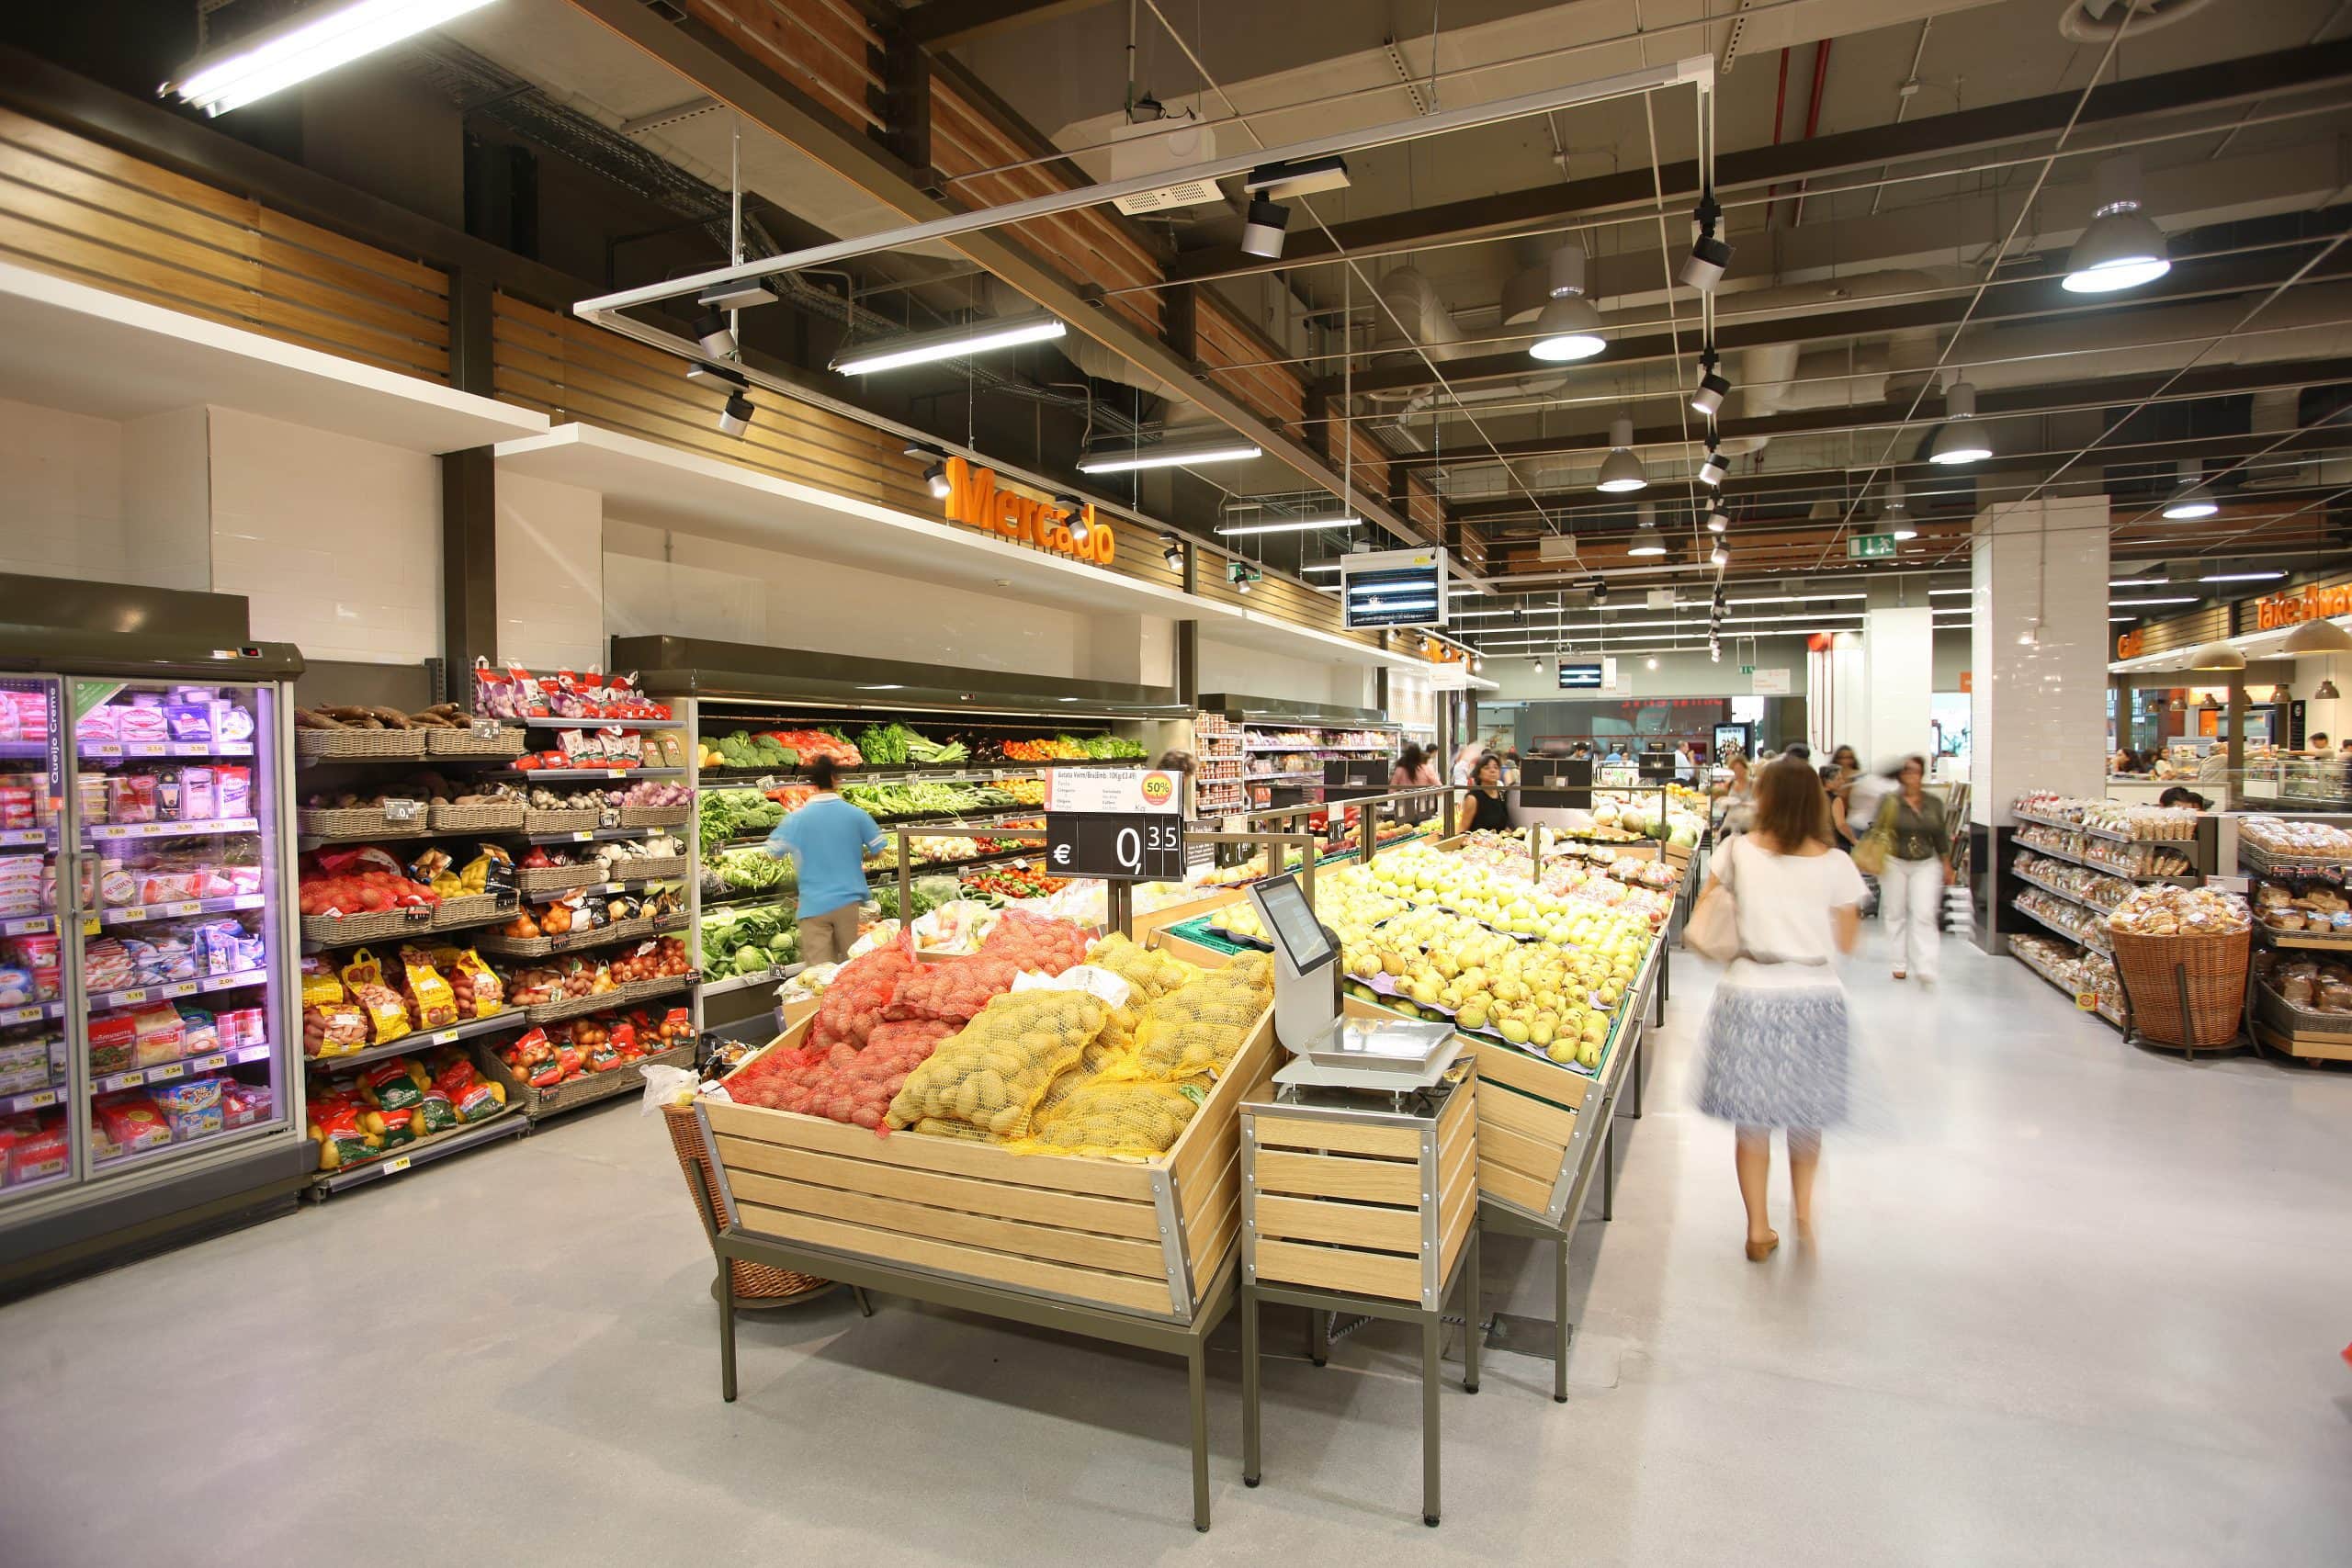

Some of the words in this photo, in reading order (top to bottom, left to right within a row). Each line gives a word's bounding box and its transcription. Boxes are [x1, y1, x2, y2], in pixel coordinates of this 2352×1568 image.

[945, 456, 1114, 564] Mercado
[2255, 592, 2301, 629] Take
[1147, 782, 1170, 793] 50%
[1053, 843, 1071, 864] €
